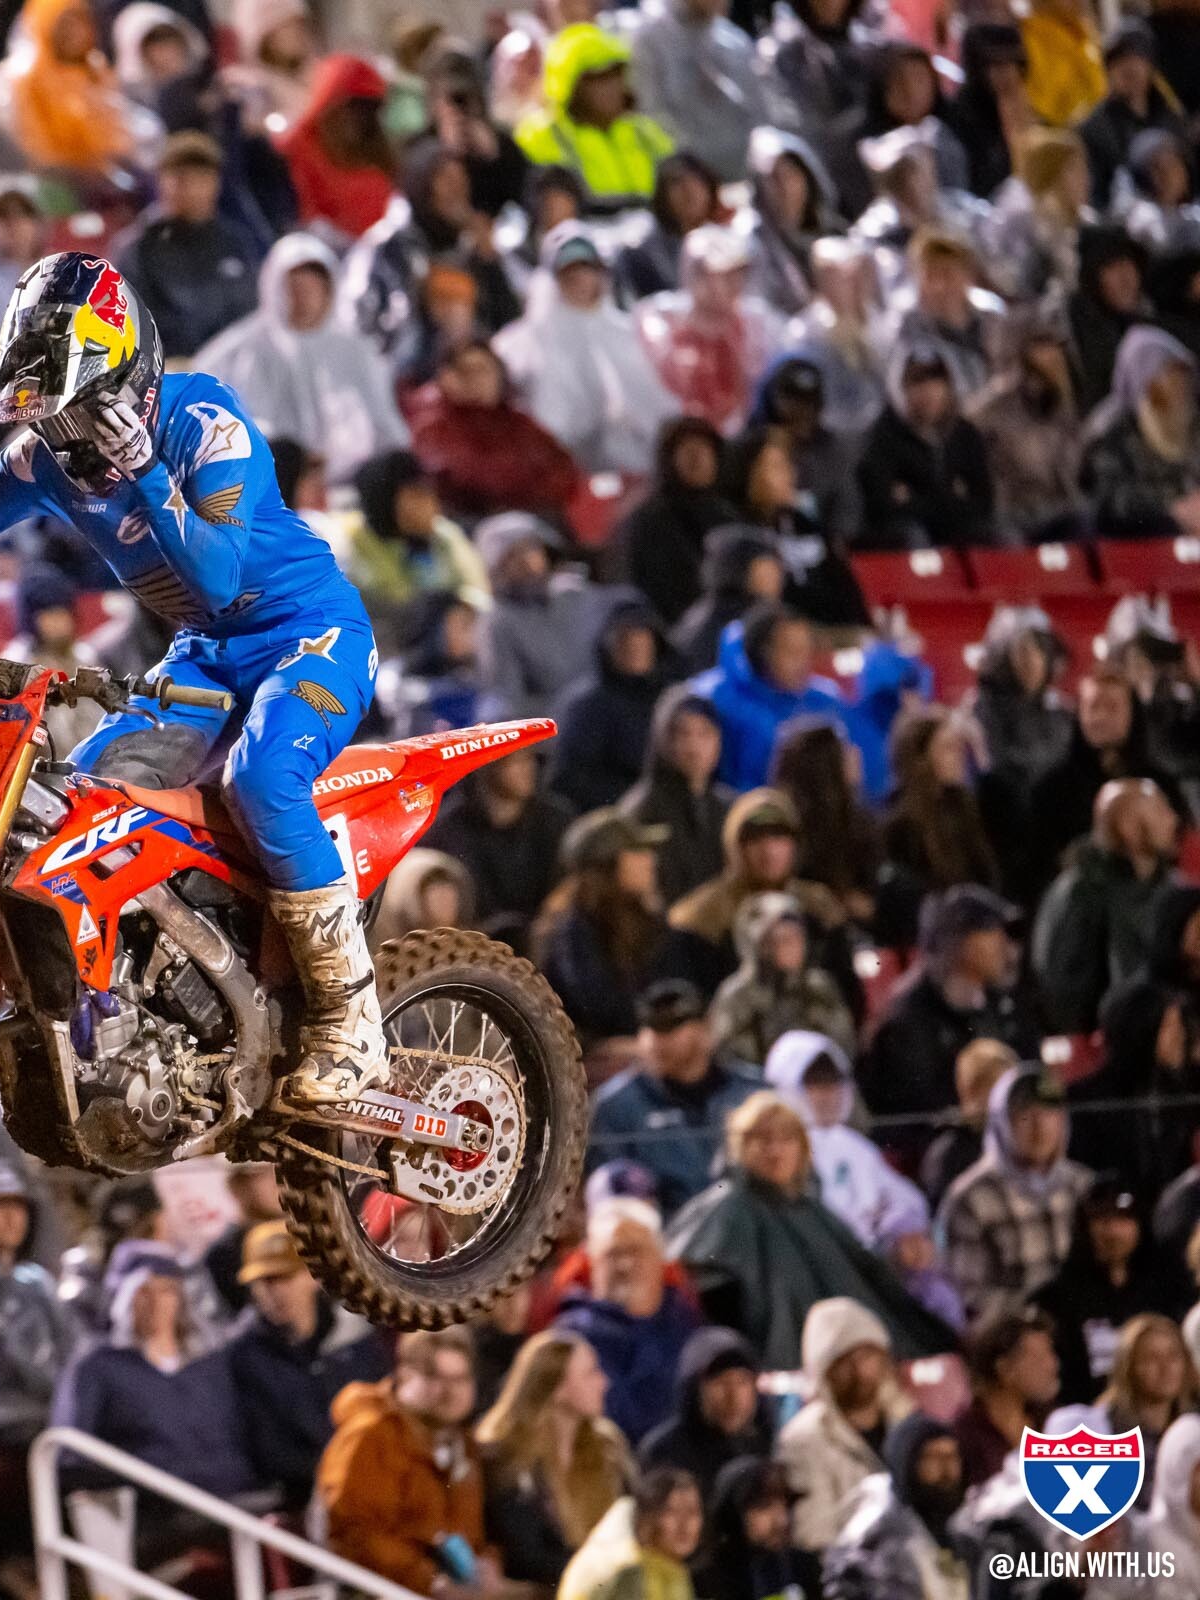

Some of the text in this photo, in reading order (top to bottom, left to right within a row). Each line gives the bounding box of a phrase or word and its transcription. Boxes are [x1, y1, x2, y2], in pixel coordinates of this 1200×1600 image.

[0, 403, 46, 421] Red Bull
[208, 516, 246, 530] ONDA
[440, 730, 521, 760] DUNLOP
[312, 767, 394, 796] HONDA
[92, 801, 129, 823] 250R
[40, 804, 149, 874] CRF
[335, 1100, 404, 1124] ENTHAL
